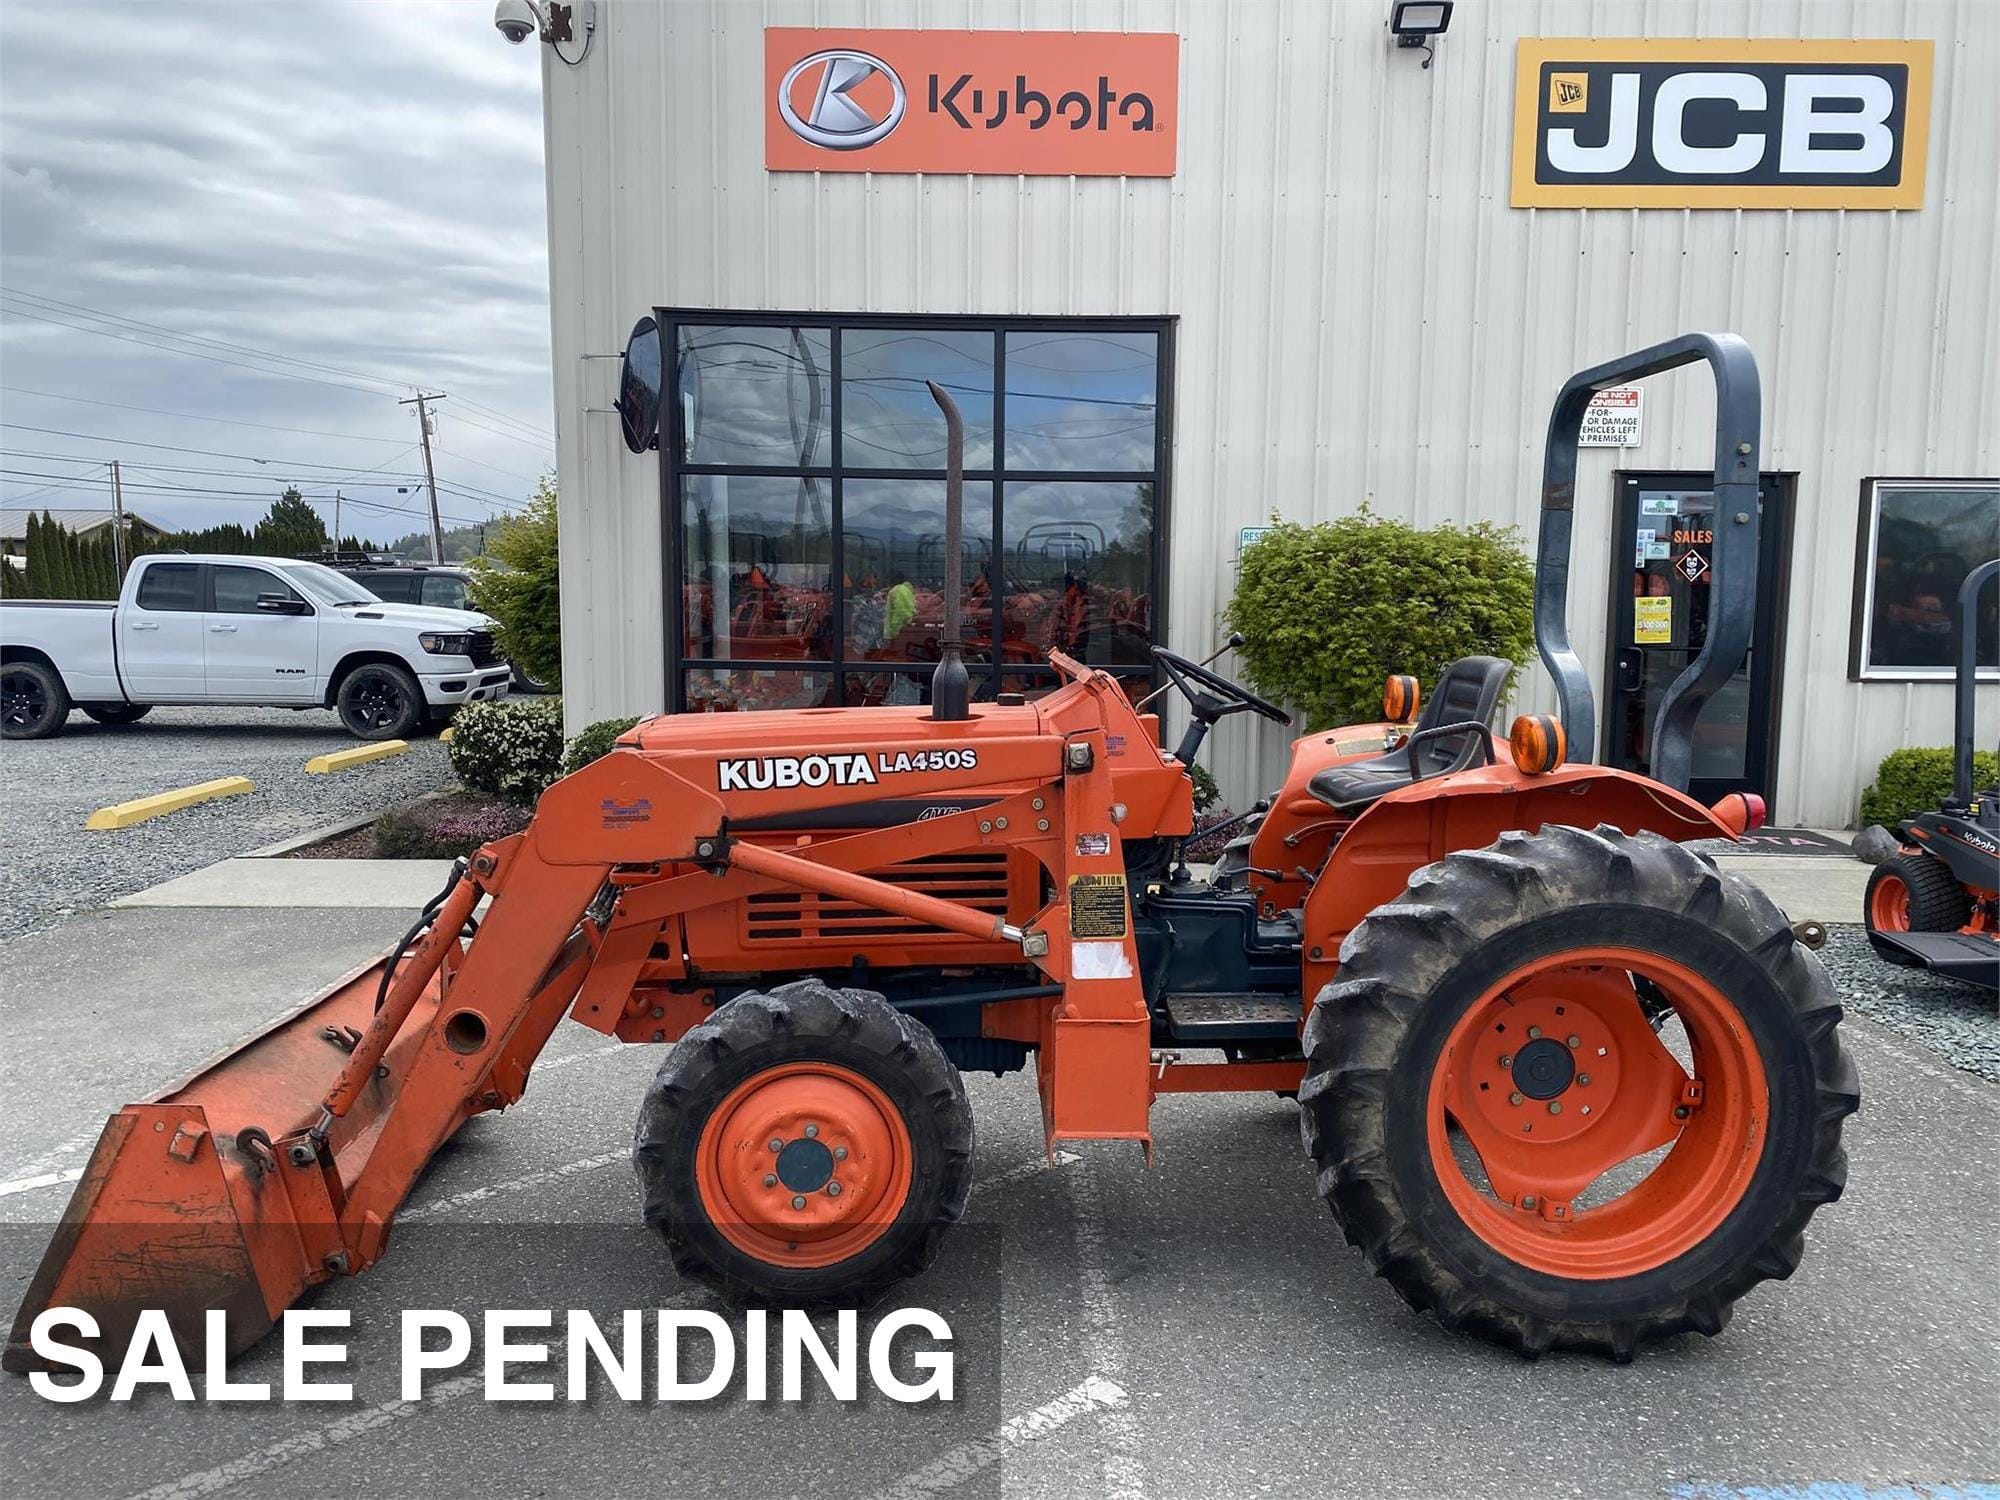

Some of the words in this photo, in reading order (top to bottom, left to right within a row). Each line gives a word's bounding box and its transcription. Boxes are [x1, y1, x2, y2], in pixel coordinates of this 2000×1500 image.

[1560, 83, 1581, 102] JCB
[928, 74, 1153, 131] Kubota
[1547, 72, 1894, 173] JCB
[1587, 417, 1600, 425] OR
[1602, 417, 1638, 425] DAMAGE
[1582, 426, 1616, 434] EHICLES
[1618, 426, 1637, 434] LEFT
[1587, 434, 1628, 442] PREMISES
[1674, 530, 1713, 544] SALES
[717, 753, 878, 792] KUBOTA
[878, 749, 978, 773] LA450S
[1738, 835, 1828, 847] OTA
[1964, 831, 1997, 853] Kubota
[1086, 875, 1123, 887] AUTION
